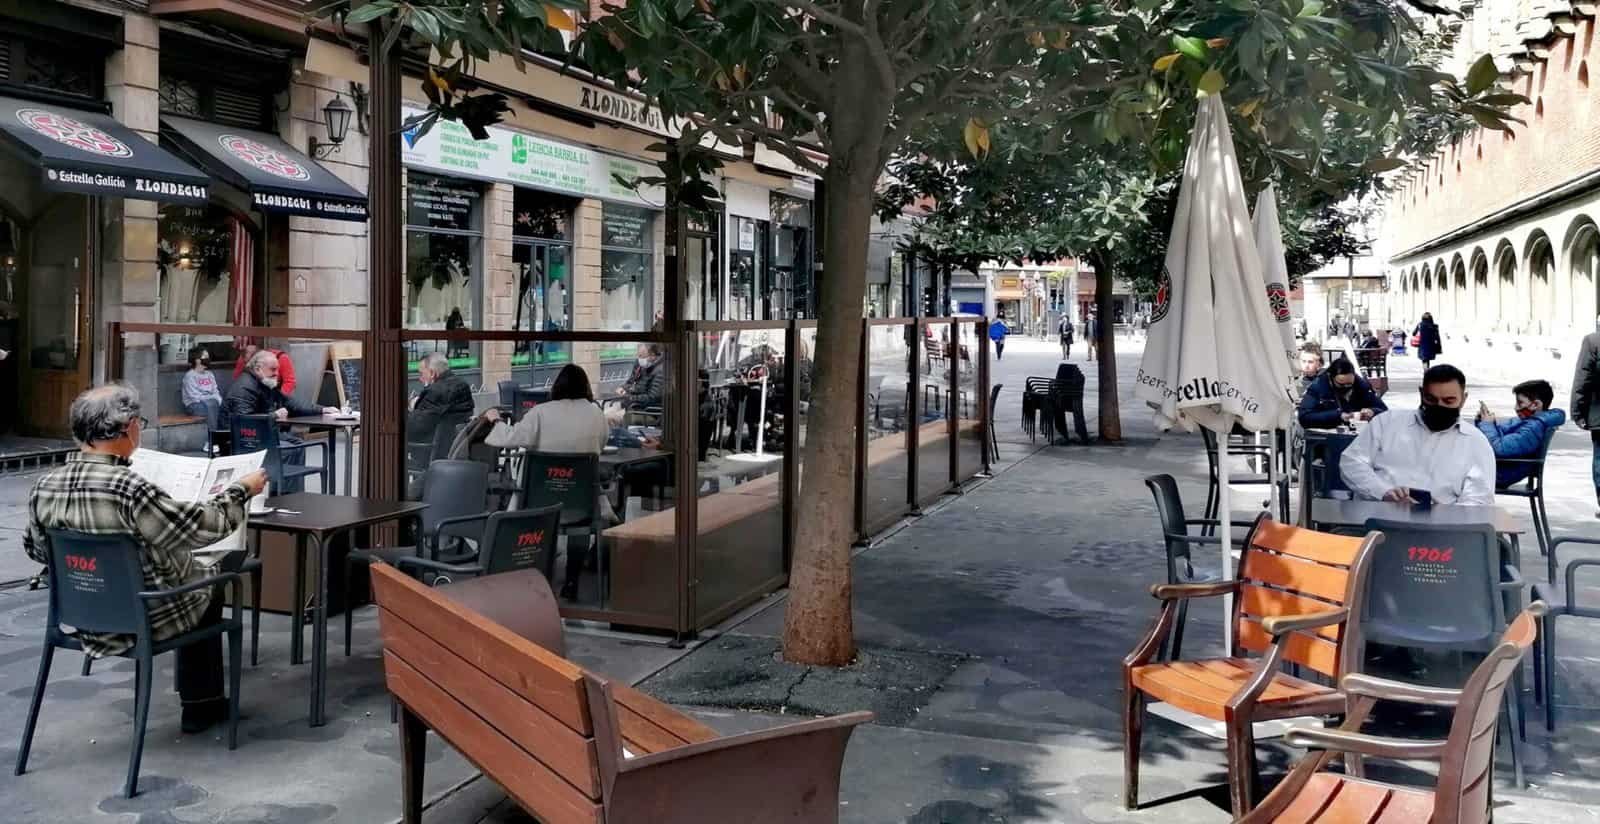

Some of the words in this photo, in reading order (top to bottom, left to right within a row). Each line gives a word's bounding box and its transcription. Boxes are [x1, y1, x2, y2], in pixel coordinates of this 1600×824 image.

[59, 170, 94, 185] Estrella
[94, 173, 126, 188] Galicia
[135, 178, 207, 199] ALONDEGUI
[254, 192, 311, 210] ALONDEGUI
[64, 554, 97, 571] 1906
[1408, 546, 1454, 562] 1906
